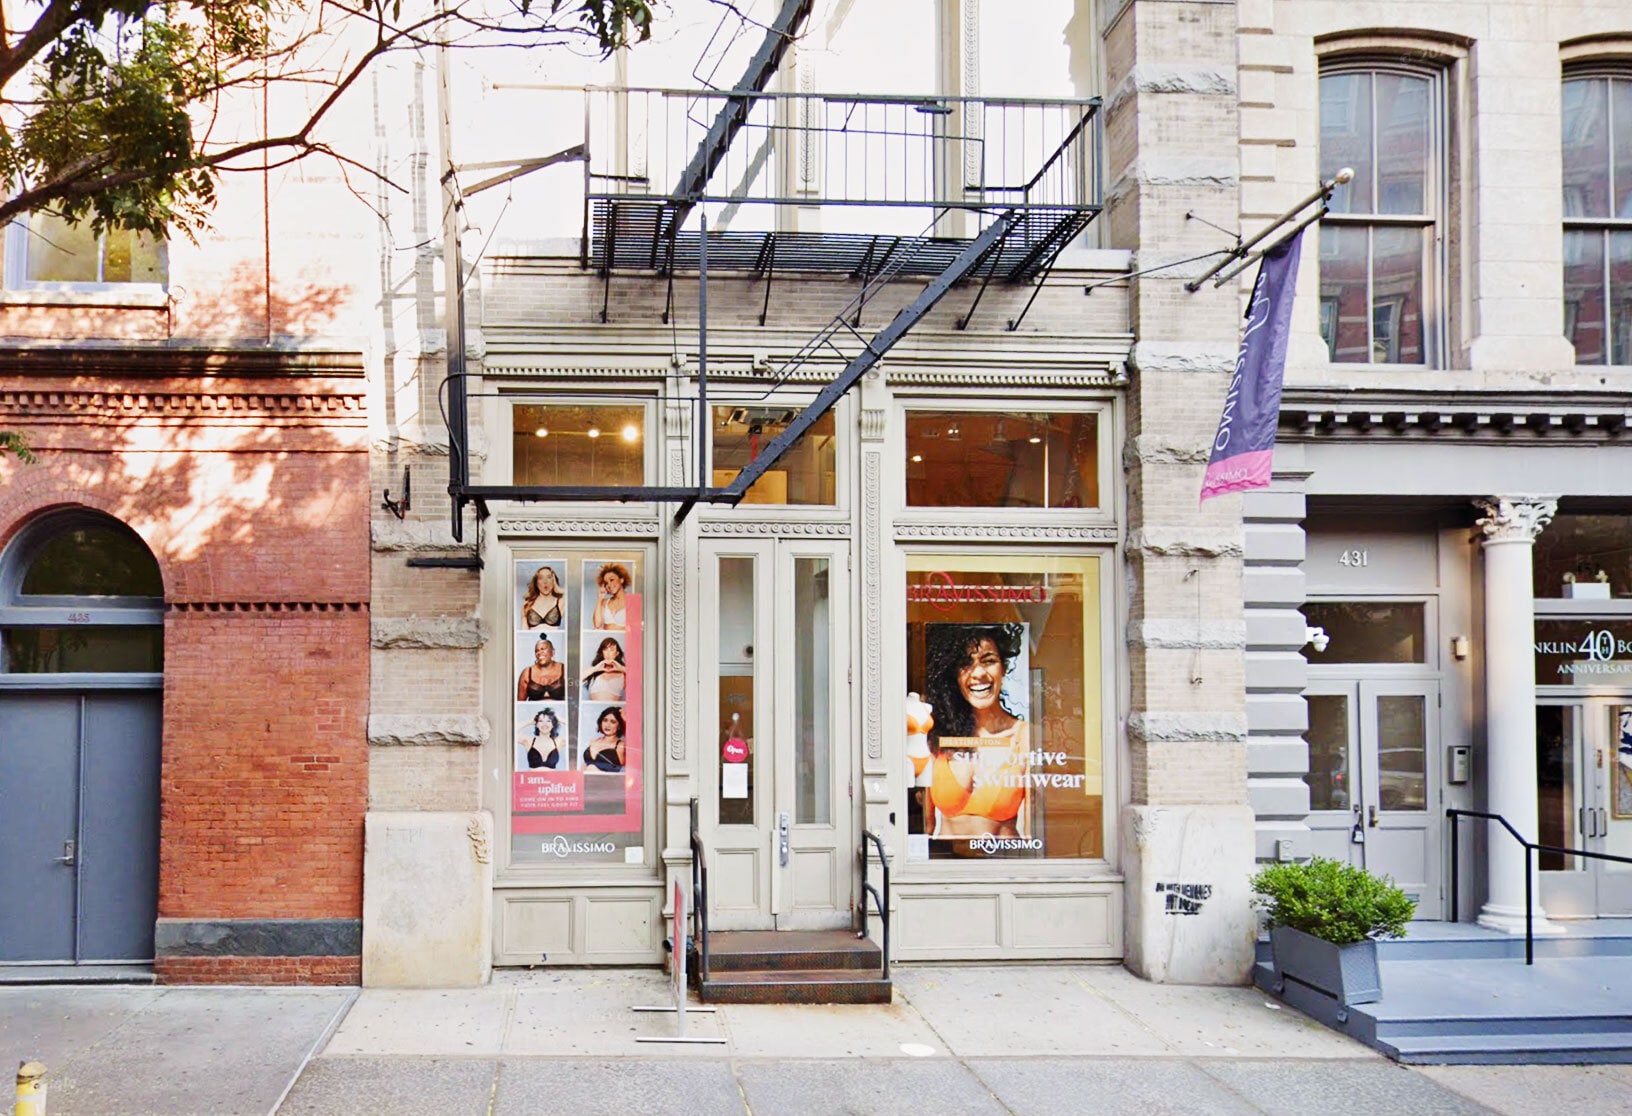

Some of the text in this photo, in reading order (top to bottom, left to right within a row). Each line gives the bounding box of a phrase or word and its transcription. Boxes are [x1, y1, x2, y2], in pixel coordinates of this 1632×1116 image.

[1337, 549, 1368, 567] 431
[906, 571, 1047, 612] BRAVISSIMO
[520, 774, 525, 784] I
[973, 773, 1086, 788] swimwear
[538, 783, 576, 796] uplifted
[541, 835, 615, 858] BRAVISSIMO
[969, 832, 1043, 855] BRAVISSIMO
